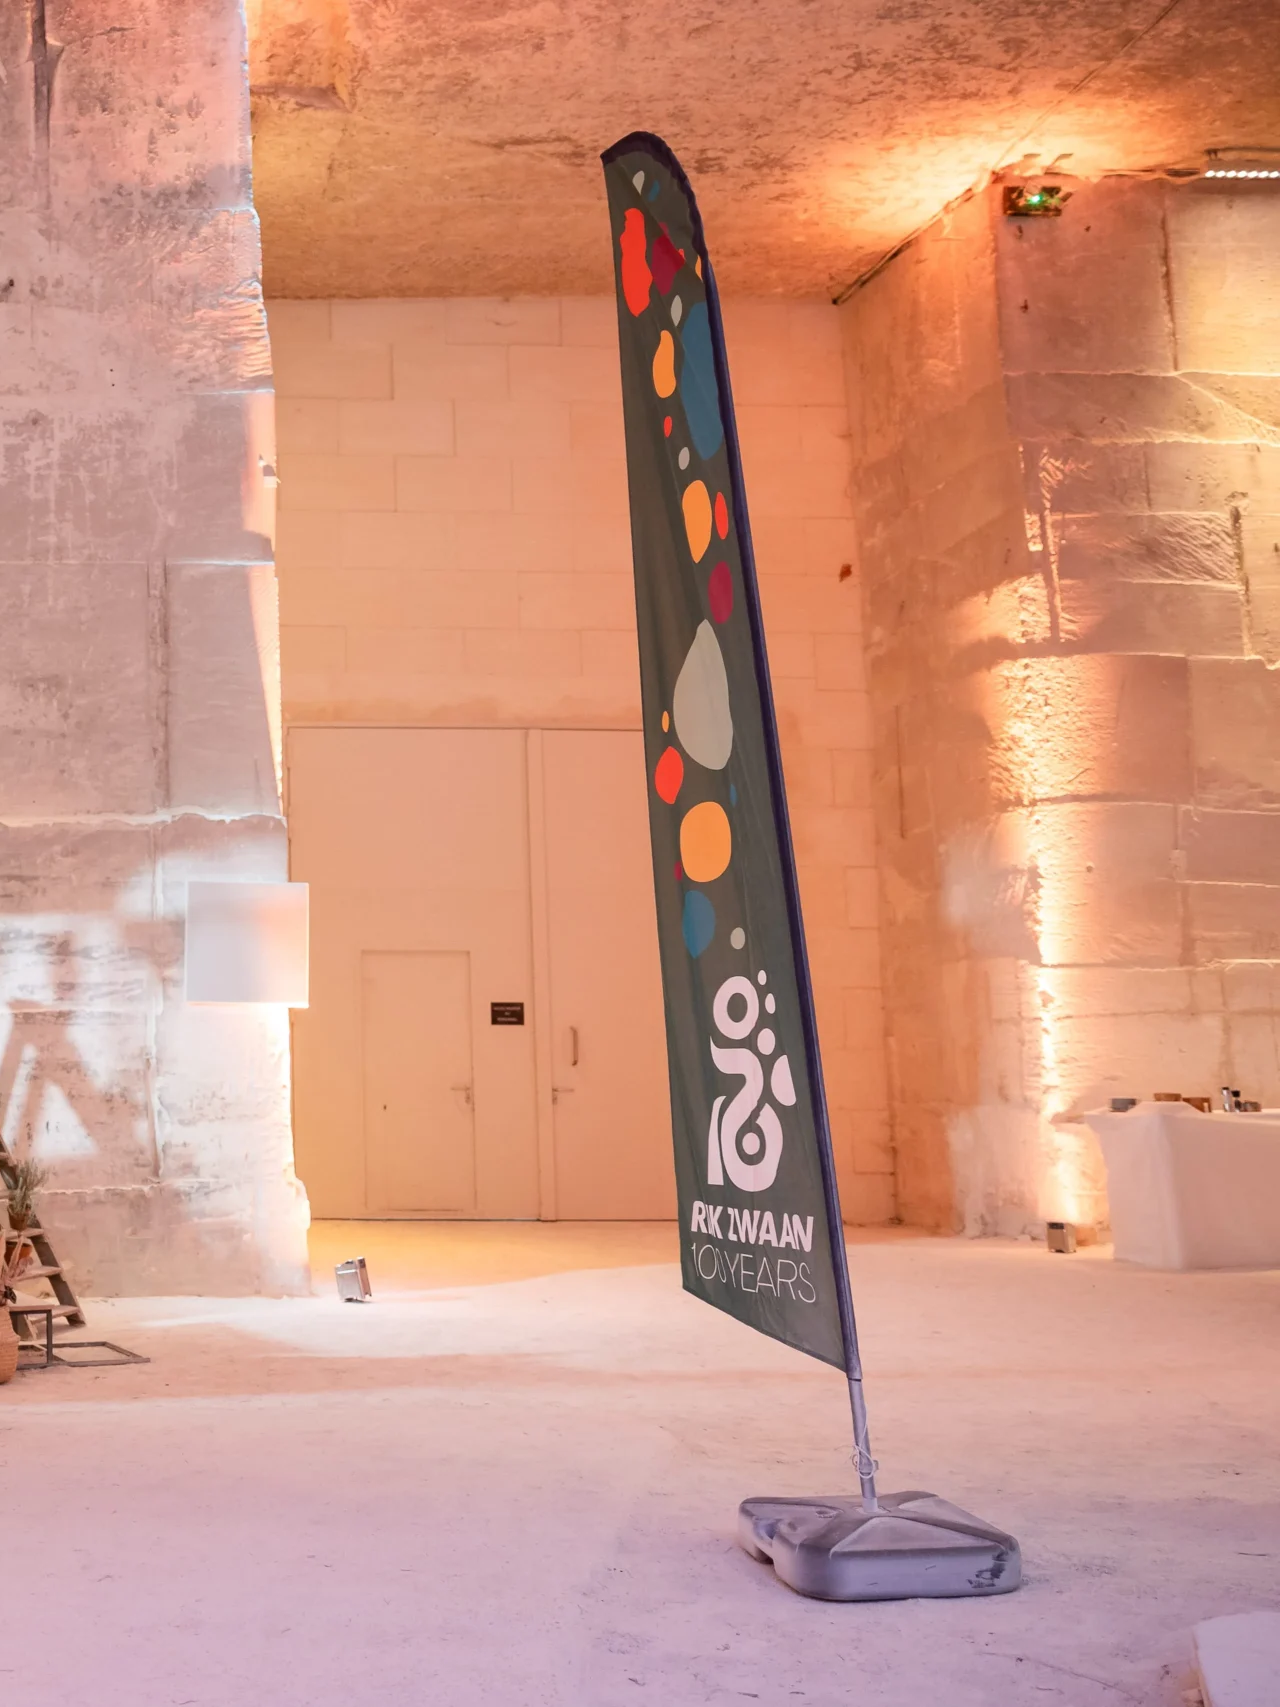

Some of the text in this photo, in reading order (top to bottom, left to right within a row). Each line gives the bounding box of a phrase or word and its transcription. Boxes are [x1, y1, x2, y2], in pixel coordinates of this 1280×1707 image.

[690, 1200, 815, 1252] RK ZWAAN
[691, 1242, 816, 1303] 100 YEARS
